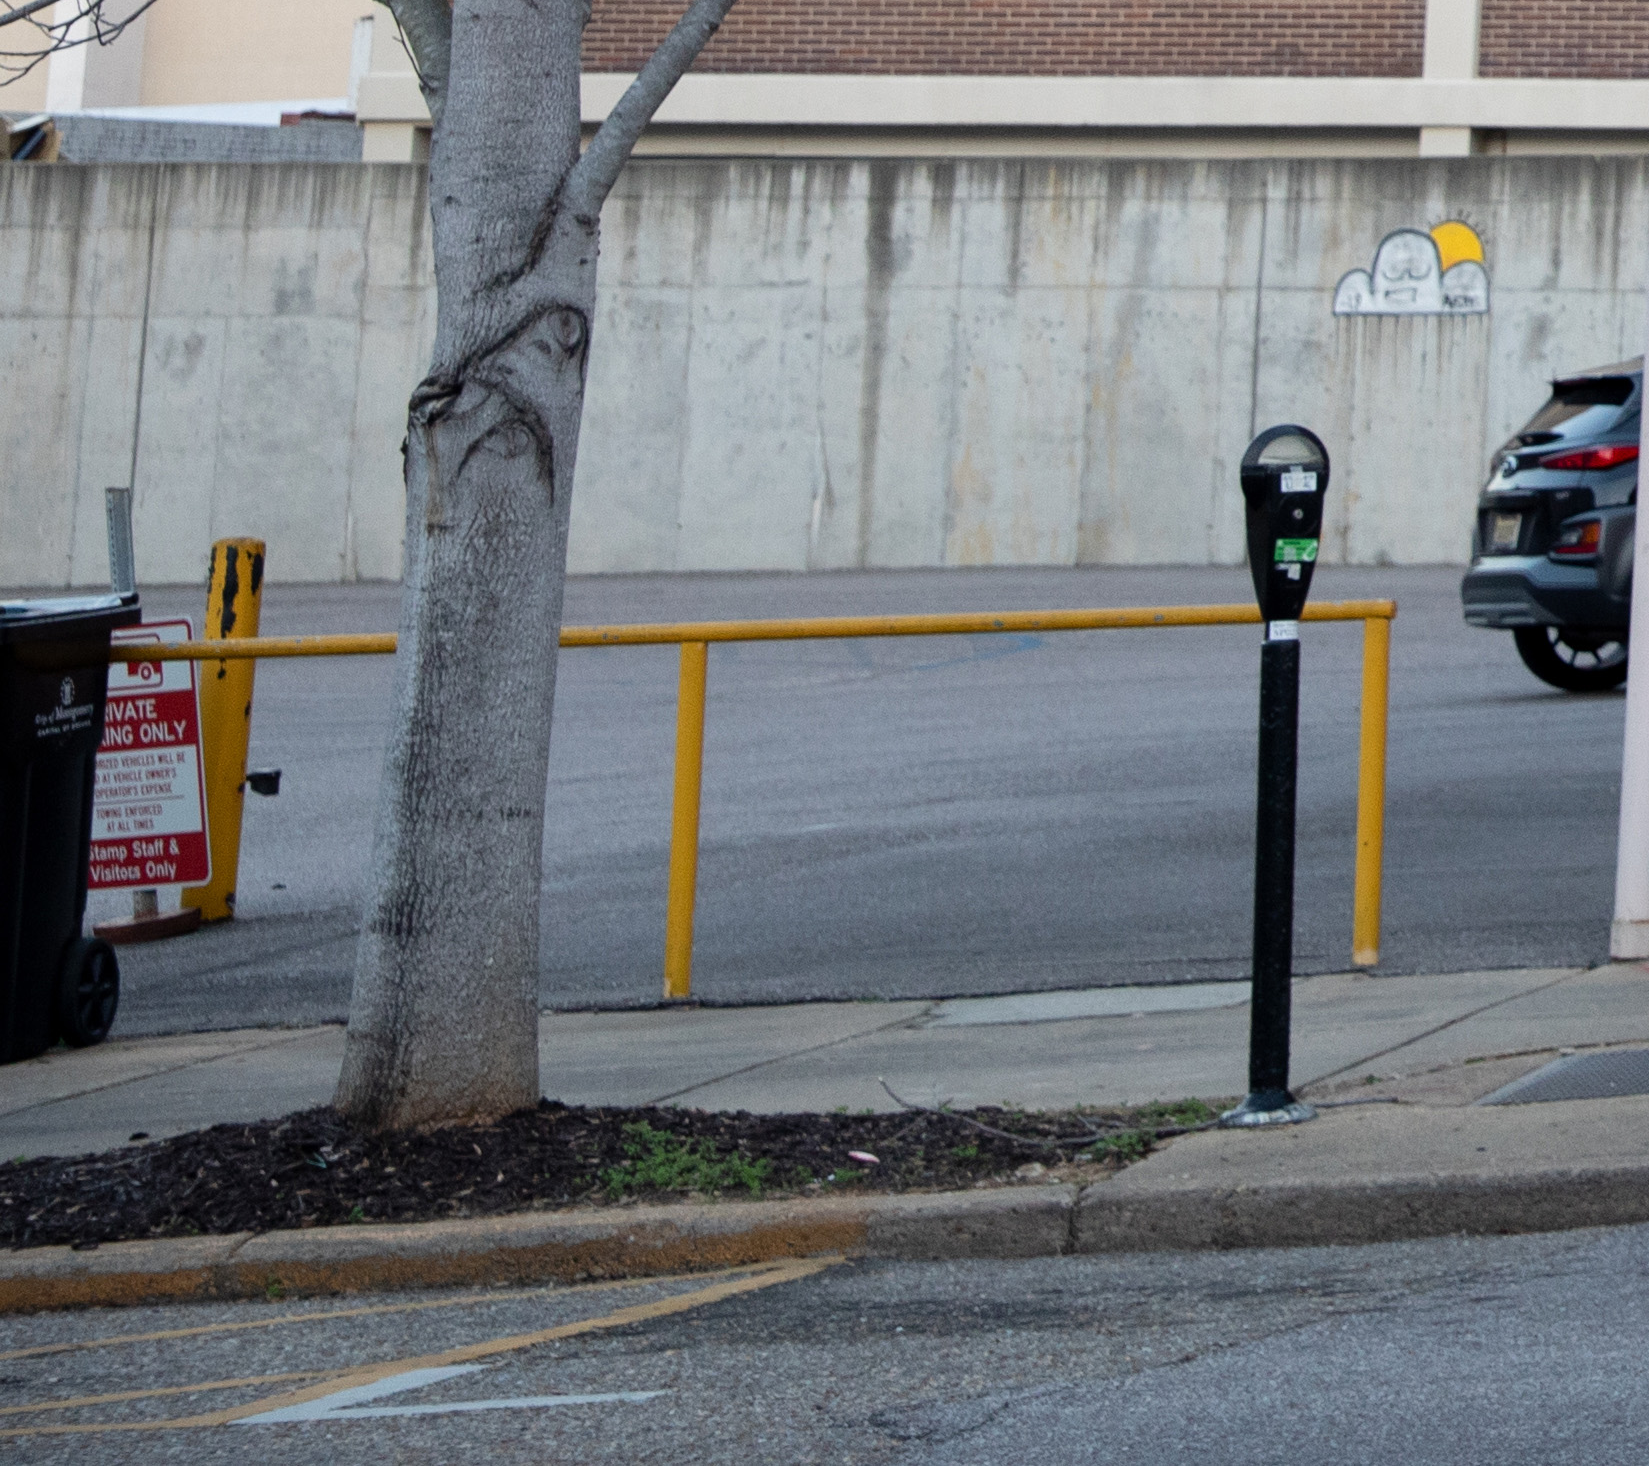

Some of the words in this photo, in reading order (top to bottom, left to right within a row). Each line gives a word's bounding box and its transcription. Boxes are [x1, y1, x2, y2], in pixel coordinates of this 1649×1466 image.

[140, 719, 187, 744] ONLY
[121, 754, 155, 768] VEHICLES
[157, 753, 174, 765] WILL
[176, 751, 186, 764] BE
[102, 772, 110, 784] AT
[113, 770, 142, 784] VEHICLE
[141, 781, 173, 796] EXPENSE
[96, 806, 122, 820] TOWING
[125, 803, 163, 818] ENFORCED
[106, 822, 115, 833] AT
[118, 820, 131, 832] ALL
[133, 818, 155, 831] TIMES
[132, 838, 164, 858] Staff
[168, 837, 180, 856] &
[90, 864, 141, 883] Visitors
[145, 860, 177, 880] Only
